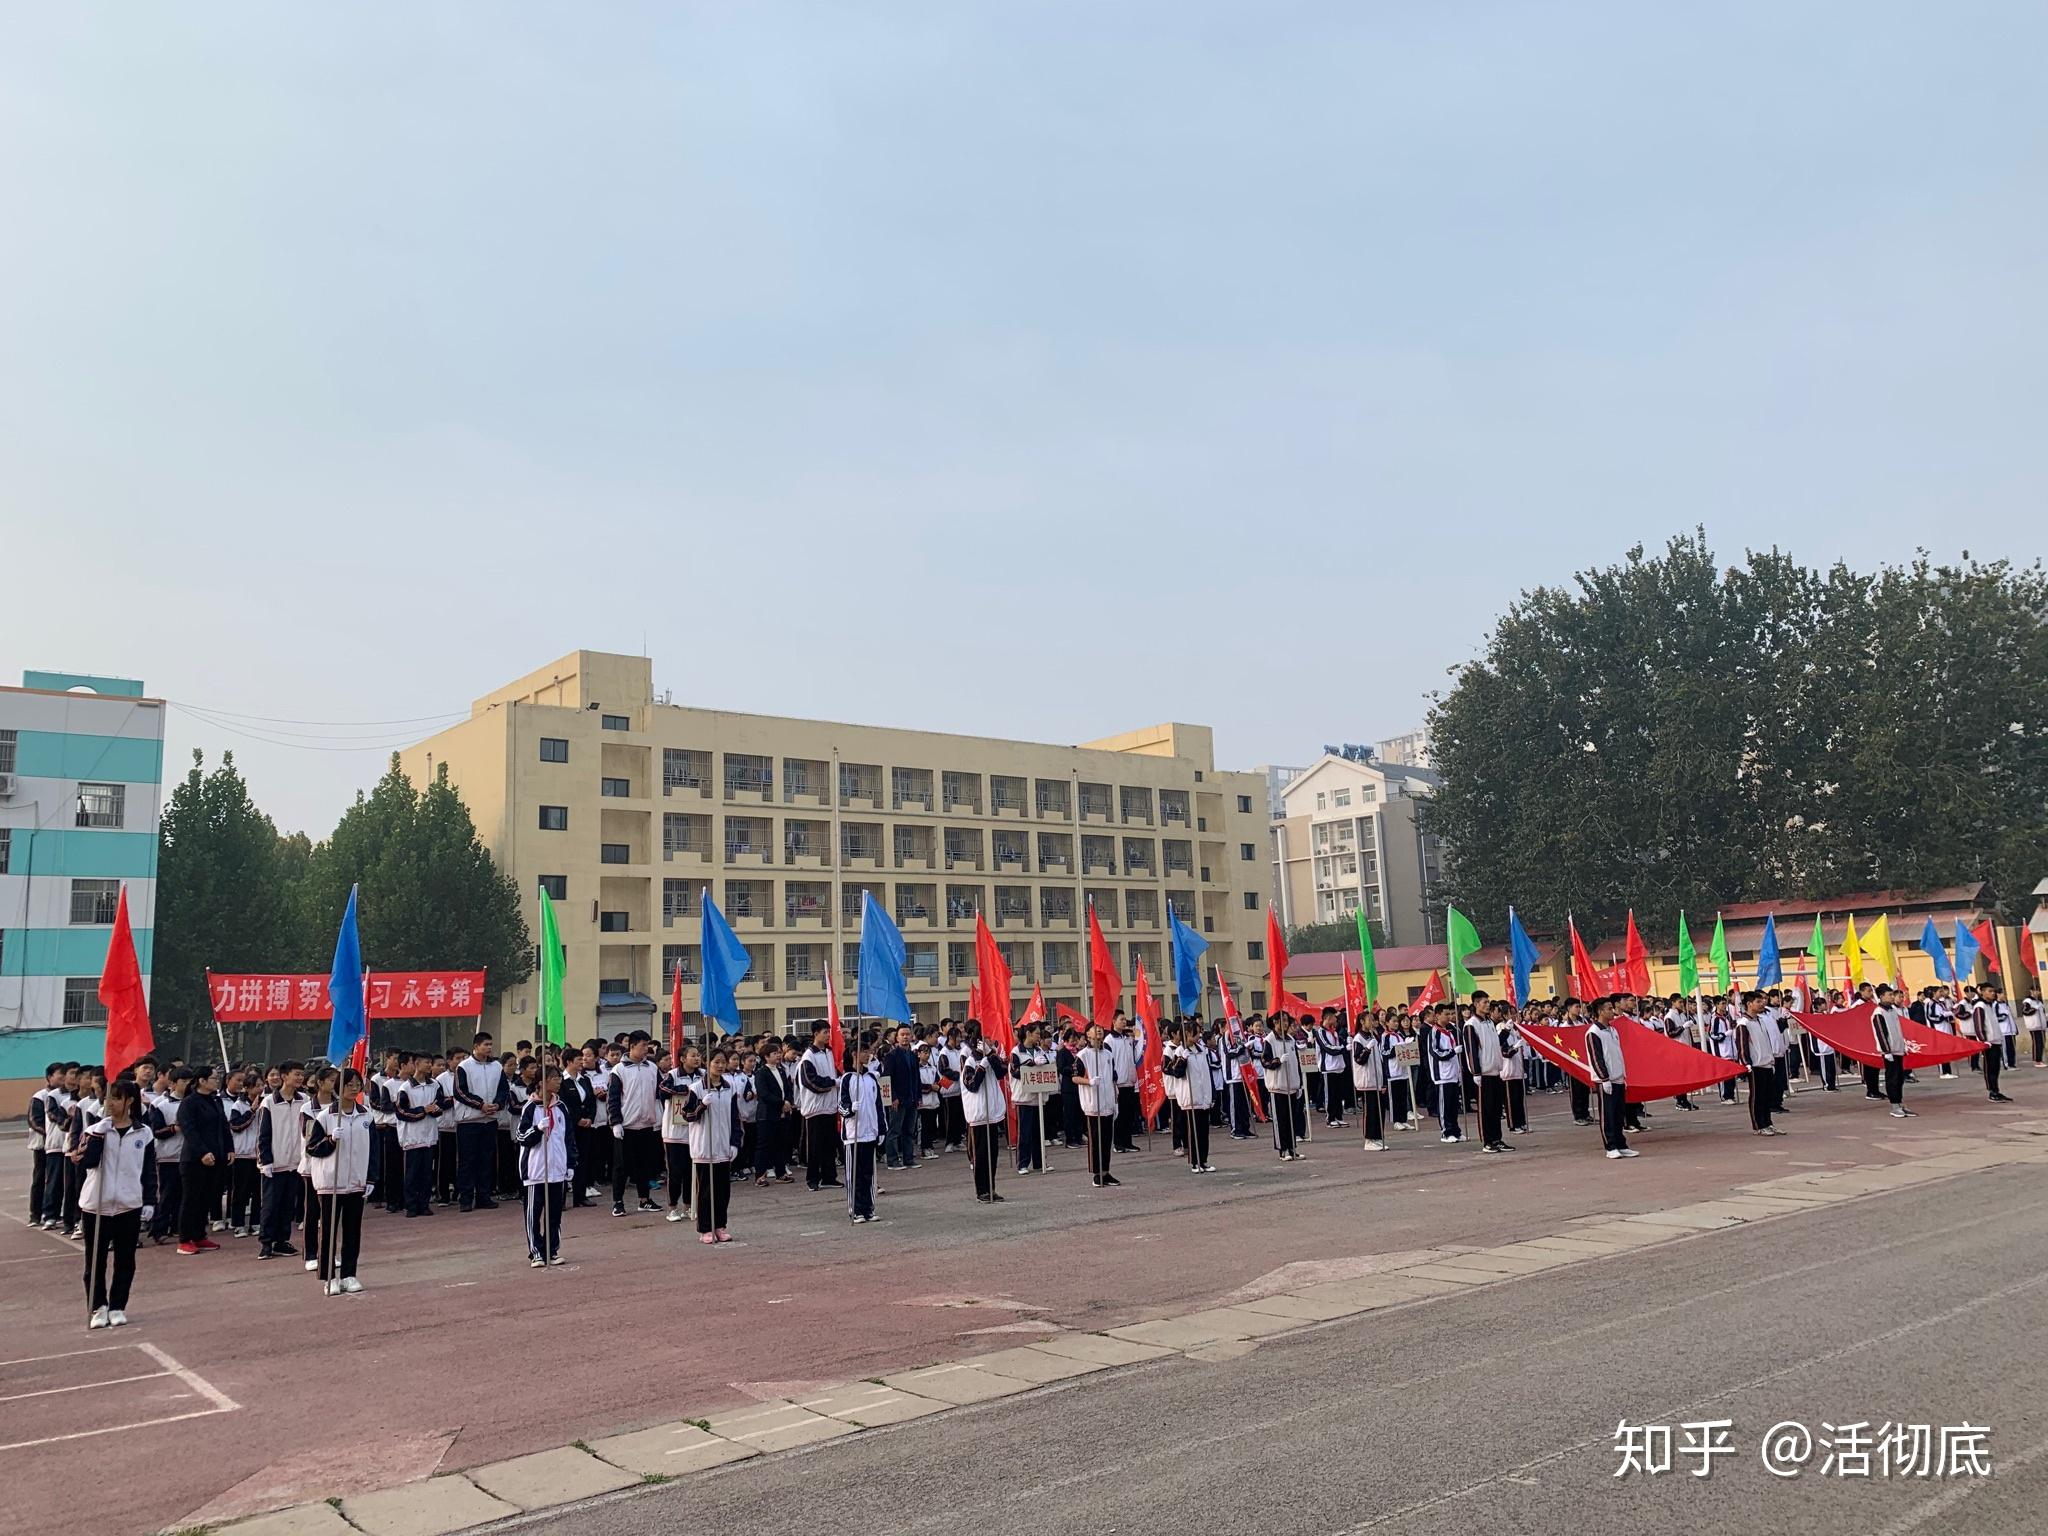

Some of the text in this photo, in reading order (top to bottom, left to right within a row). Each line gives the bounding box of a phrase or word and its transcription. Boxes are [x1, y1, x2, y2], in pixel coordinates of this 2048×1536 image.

[1023, 1070, 1057, 1086] 八年级四班
